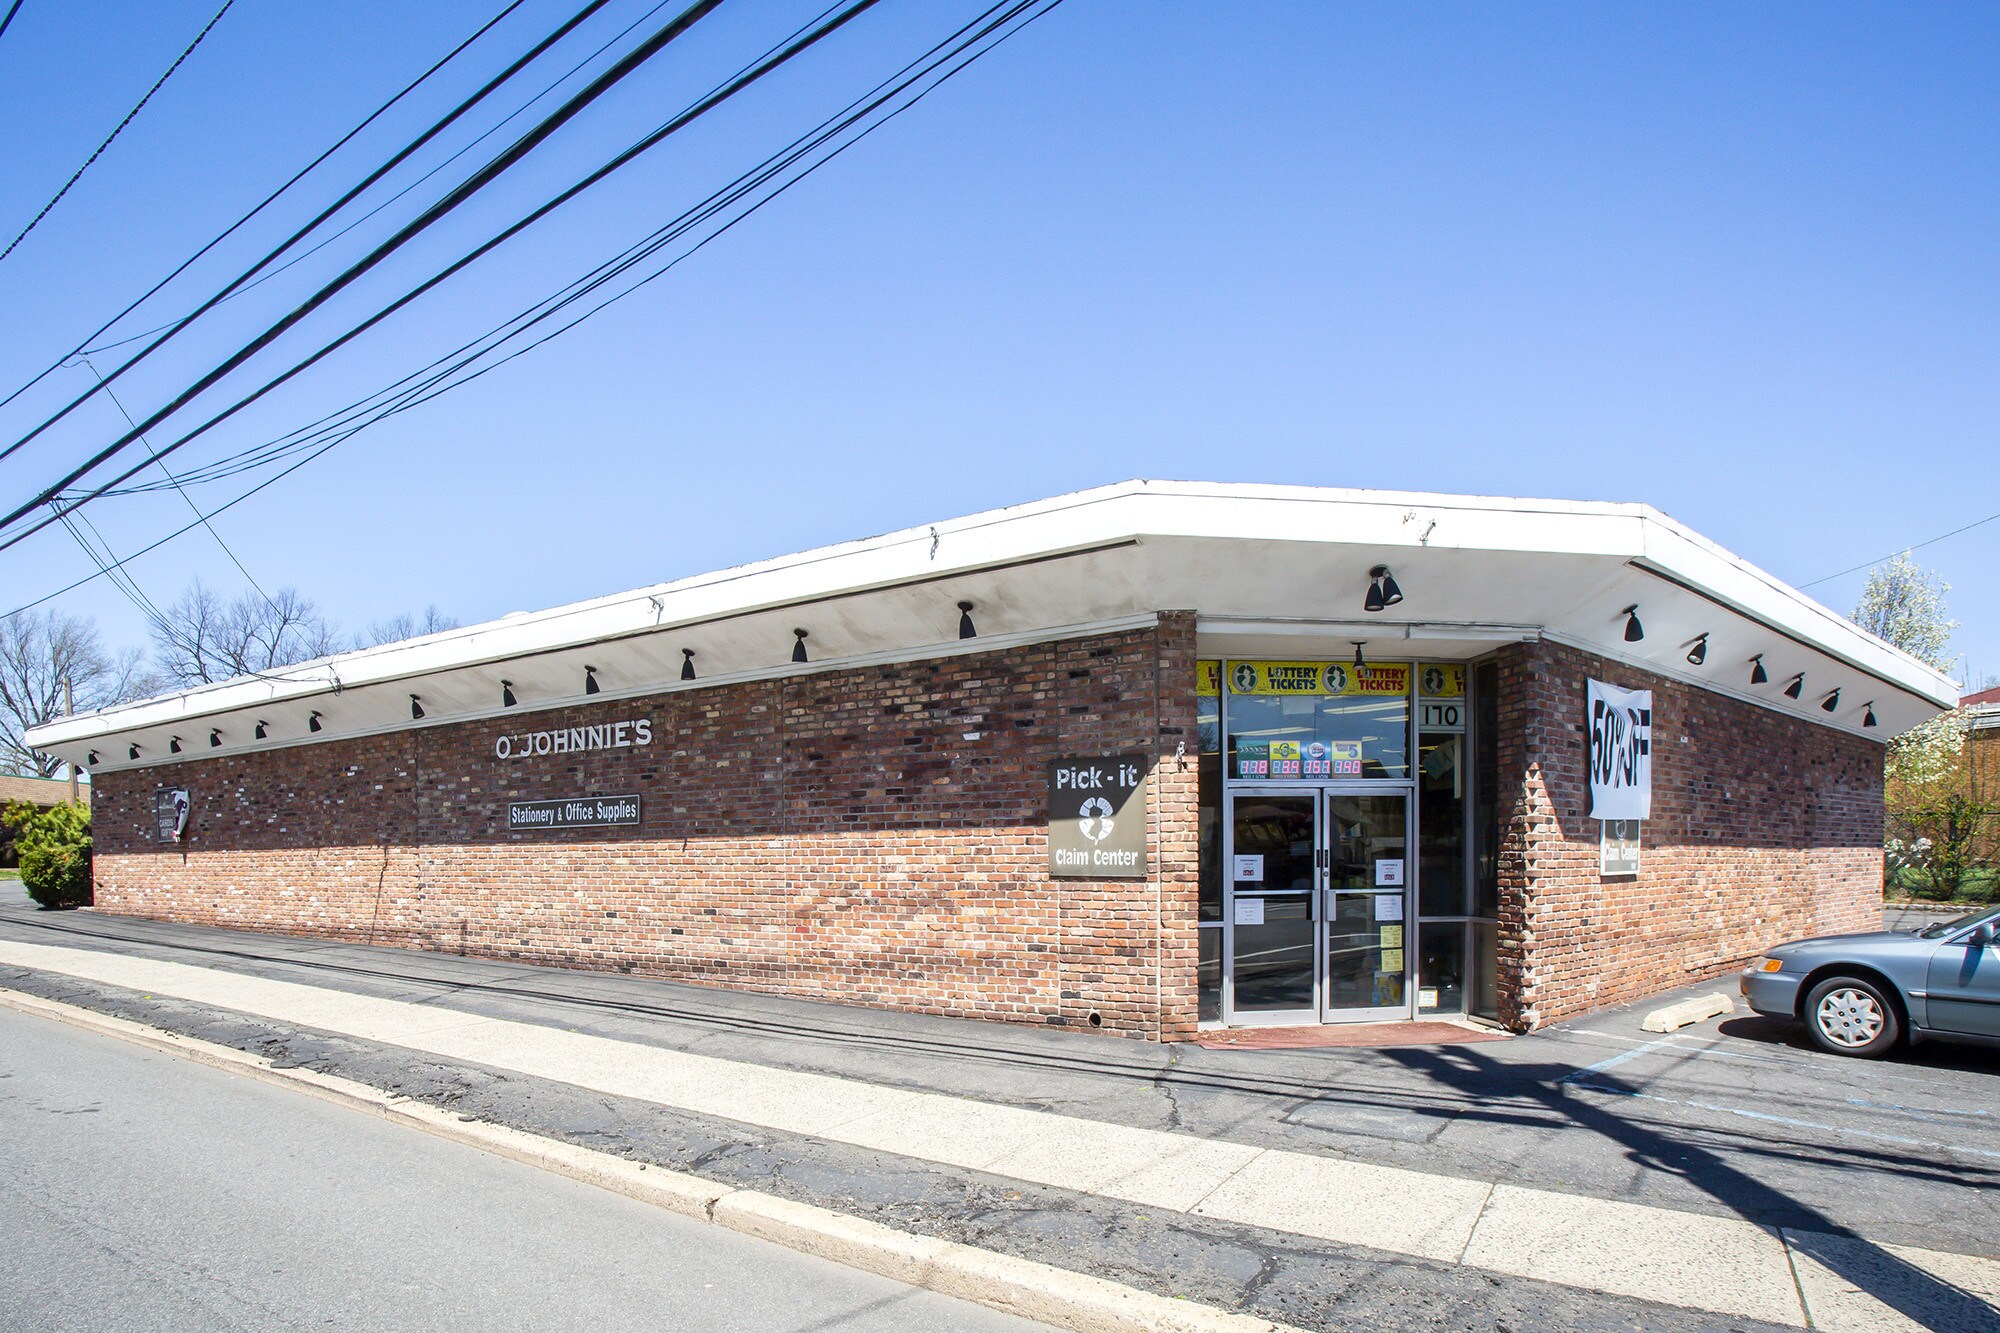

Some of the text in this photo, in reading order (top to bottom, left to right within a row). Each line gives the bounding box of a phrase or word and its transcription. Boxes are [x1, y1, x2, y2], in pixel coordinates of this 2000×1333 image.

[1268, 667, 1318, 679] LOTTERY
[1357, 668, 1406, 679] LOTTERY
[1270, 679, 1317, 690] TICKETS
[1359, 680, 1404, 691] TICKETS
[1425, 705, 1458, 726] 170
[496, 719, 652, 759] O'JOHNNIE'S
[511, 800, 637, 825] Stationery & Office Supplies
[1055, 848, 1139, 866] Claim Center
